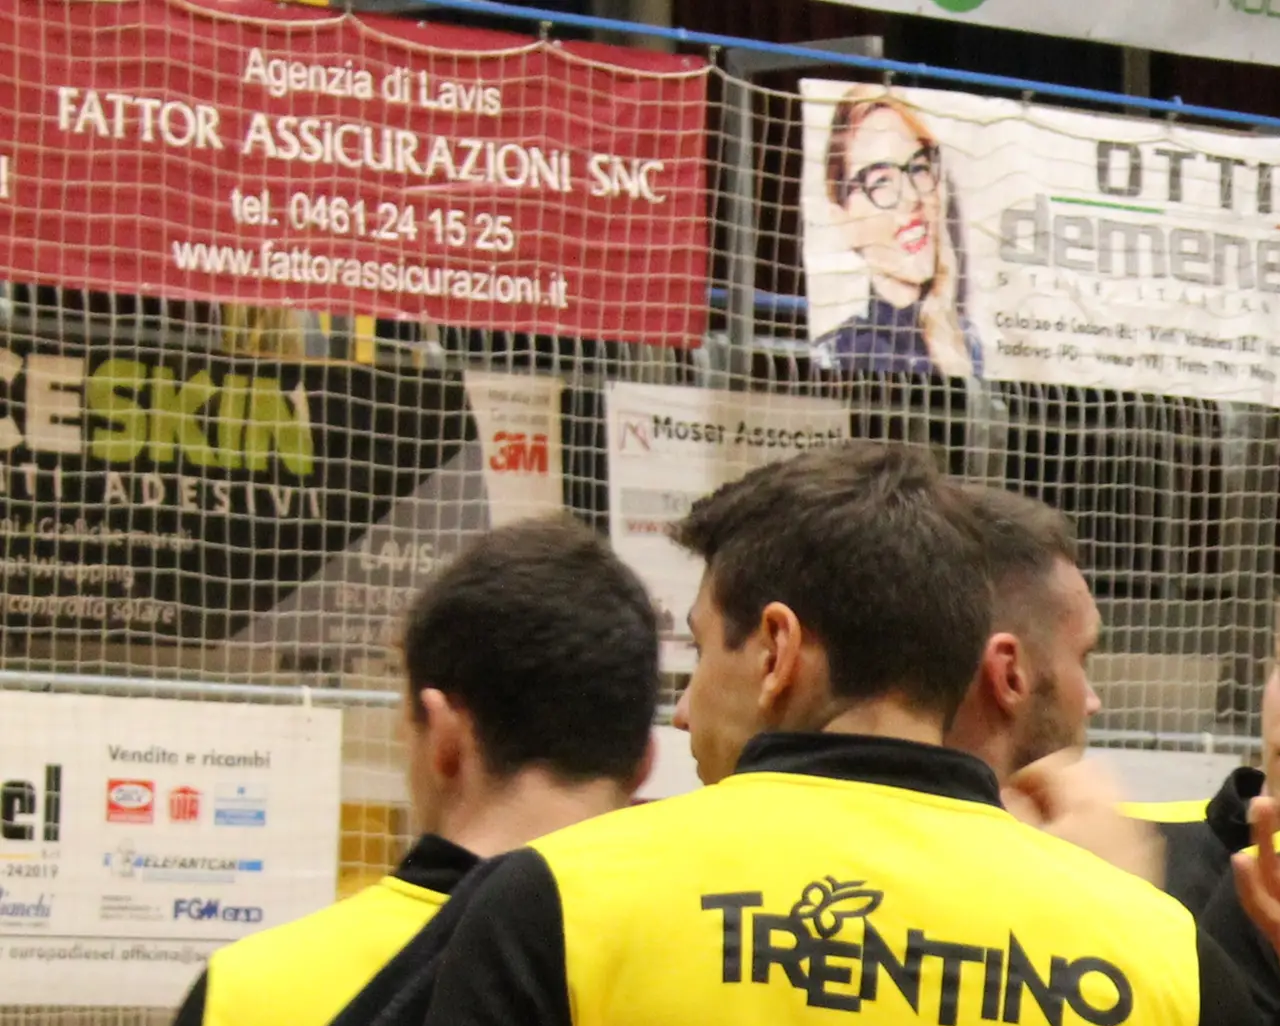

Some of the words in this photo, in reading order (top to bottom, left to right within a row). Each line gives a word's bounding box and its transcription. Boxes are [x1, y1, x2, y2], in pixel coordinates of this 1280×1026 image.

[245, 47, 374, 102] Agenzia
[382, 66, 412, 104] di
[419, 76, 502, 116] Lavis
[58, 86, 224, 150] FATTOR
[242, 113, 572, 193] ASSICURAZIONI
[590, 153, 666, 204] SNC
[230, 188, 279, 228] tel.
[290, 192, 418, 242] 0461.24
[428, 211, 467, 248] 15
[475, 214, 515, 252] 25
[172, 237, 570, 309] www.fattorassicurazioni.it
[490, 431, 548, 473] 3M
[653, 415, 725, 444] Moser
[108, 745, 179, 765] Vendita
[185, 753, 197, 765] e
[202, 751, 271, 769] ricambi
